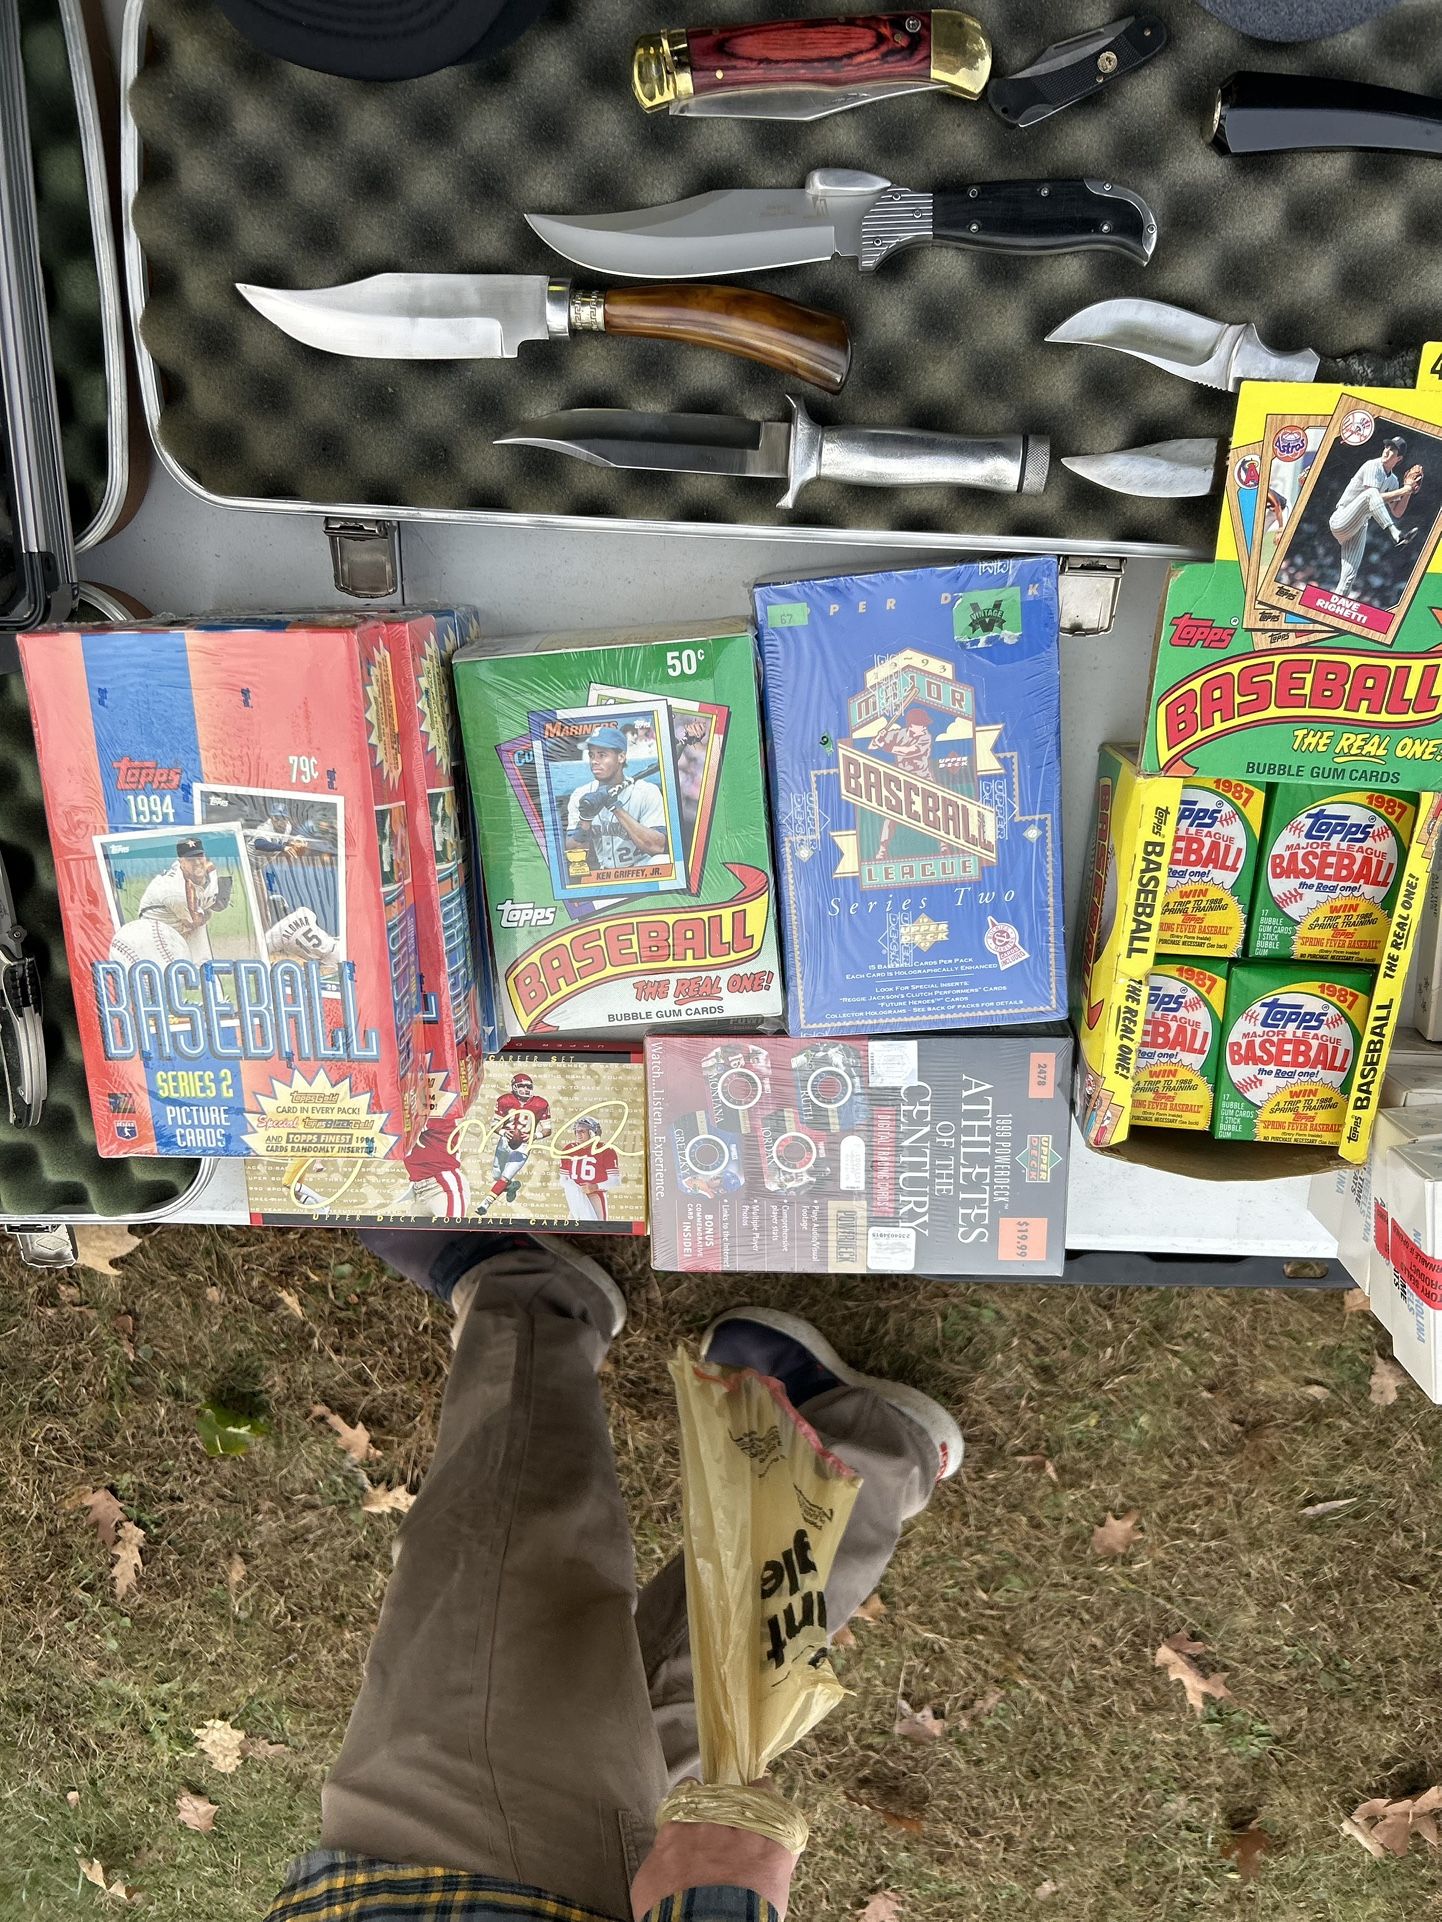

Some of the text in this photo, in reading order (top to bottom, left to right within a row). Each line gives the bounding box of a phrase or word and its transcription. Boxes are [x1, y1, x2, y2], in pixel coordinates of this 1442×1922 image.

[1275, 437, 1305, 454] Astros
[971, 608, 1003, 620] VINTAGE
[1316, 599, 1367, 624] RIGHETTI
[1330, 594, 1361, 611] DAVE
[780, 613, 793, 624] 67
[667, 649, 705, 677] 50¢
[1165, 659, 1442, 750] BASEBALL
[1292, 729, 1335, 752] THE
[1335, 733, 1391, 758] REAL
[288, 756, 318, 783] 79¢
[1246, 762, 1400, 783] BUBBLE GUM CARDS
[842, 751, 994, 853] BASEBALL
[1213, 779, 1255, 808] 1987
[127, 795, 175, 823] 1994
[1366, 794, 1407, 823] 1987
[1185, 828, 1235, 844] LEAGUE
[1285, 841, 1387, 860] MAJOR LEAGUE
[596, 868, 662, 881] KEN GRIFFEY, JR.
[867, 859, 973, 882] LEAGUE
[1189, 870, 1210, 878] one!
[1271, 850, 1394, 888] BASEBALL
[1179, 889, 1208, 898] WIN
[1298, 881, 1361, 892] the Real one!
[828, 887, 1014, 917] Series Two
[1126, 840, 1165, 959] BASEBALL
[1191, 904, 1228, 912] TRAINING
[1330, 903, 1359, 912] WIN
[901, 923, 948, 933] UPPER
[1259, 925, 1292, 934] GUM CARDS
[1341, 918, 1378, 928] TRAINING
[295, 928, 321, 954] 15
[1325, 938, 1346, 948] FEVER
[514, 909, 754, 1017] BASEBALL
[1001, 951, 1026, 967] INCLUDED
[633, 971, 774, 1000] THE REAL ONE!
[1126, 979, 1142, 1006] THE
[1176, 967, 1217, 994] 1987
[1354, 998, 1394, 1111] BASEBALL
[1383, 953, 1400, 980] THE
[1392, 914, 1410, 951] REAL
[1401, 873, 1419, 911] ONE!
[1318, 983, 1360, 1012] 1987
[92, 960, 380, 1062] BASEBALL
[608, 1005, 724, 1022] BUBBLE GUM CARDS
[1152, 1012, 1201, 1029] LEAGUE
[1121, 1007, 1139, 1045] REAL
[1242, 1031, 1342, 1046] MAJOR LEAGUE
[1114, 1045, 1134, 1080] ONE!
[1229, 1038, 1350, 1073] BASEBALL
[156, 1069, 233, 1099] SERIES 2
[1037, 1063, 1046, 1086] 2478
[1149, 1070, 1177, 1078] WIN
[1257, 1068, 1273, 1077] the
[1275, 1069, 1296, 1078] Real
[708, 1073, 724, 1124] MONTANA
[1161, 1084, 1198, 1092] TRAINING
[1289, 1088, 1319, 1098] WIN
[166, 1106, 230, 1126] PICTURE
[276, 1106, 297, 1114] CARD
[800, 1090, 814, 1120] RUTH
[1222, 1102, 1244, 1110] BUBBLE
[1269, 1103, 1338, 1114] SPRING TRAINING
[257, 1116, 299, 1130] Special
[996, 1113, 1012, 1139] 1999
[1287, 1122, 1308, 1131] FEVER
[176, 1128, 226, 1148] CARDS
[288, 1135, 318, 1143] TOPPS
[321, 1135, 351, 1143] FINEST
[876, 1115, 889, 1180] DIGITAL TRADING
[674, 1129, 690, 1175] GRETZKY
[899, 1081, 932, 1236] CENTURY
[935, 1121, 955, 1196] OF THE
[958, 1074, 994, 1243] ATHLETES
[1029, 1137, 1038, 1181] DECK
[1040, 1137, 1048, 1181] UPPER
[570, 1156, 597, 1180] 16
[312, 1213, 580, 1227] UPPER DECK FOOTBALL CARDS
[705, 1215, 714, 1247] BONUS
[1017, 1221, 1029, 1257] $19.99
